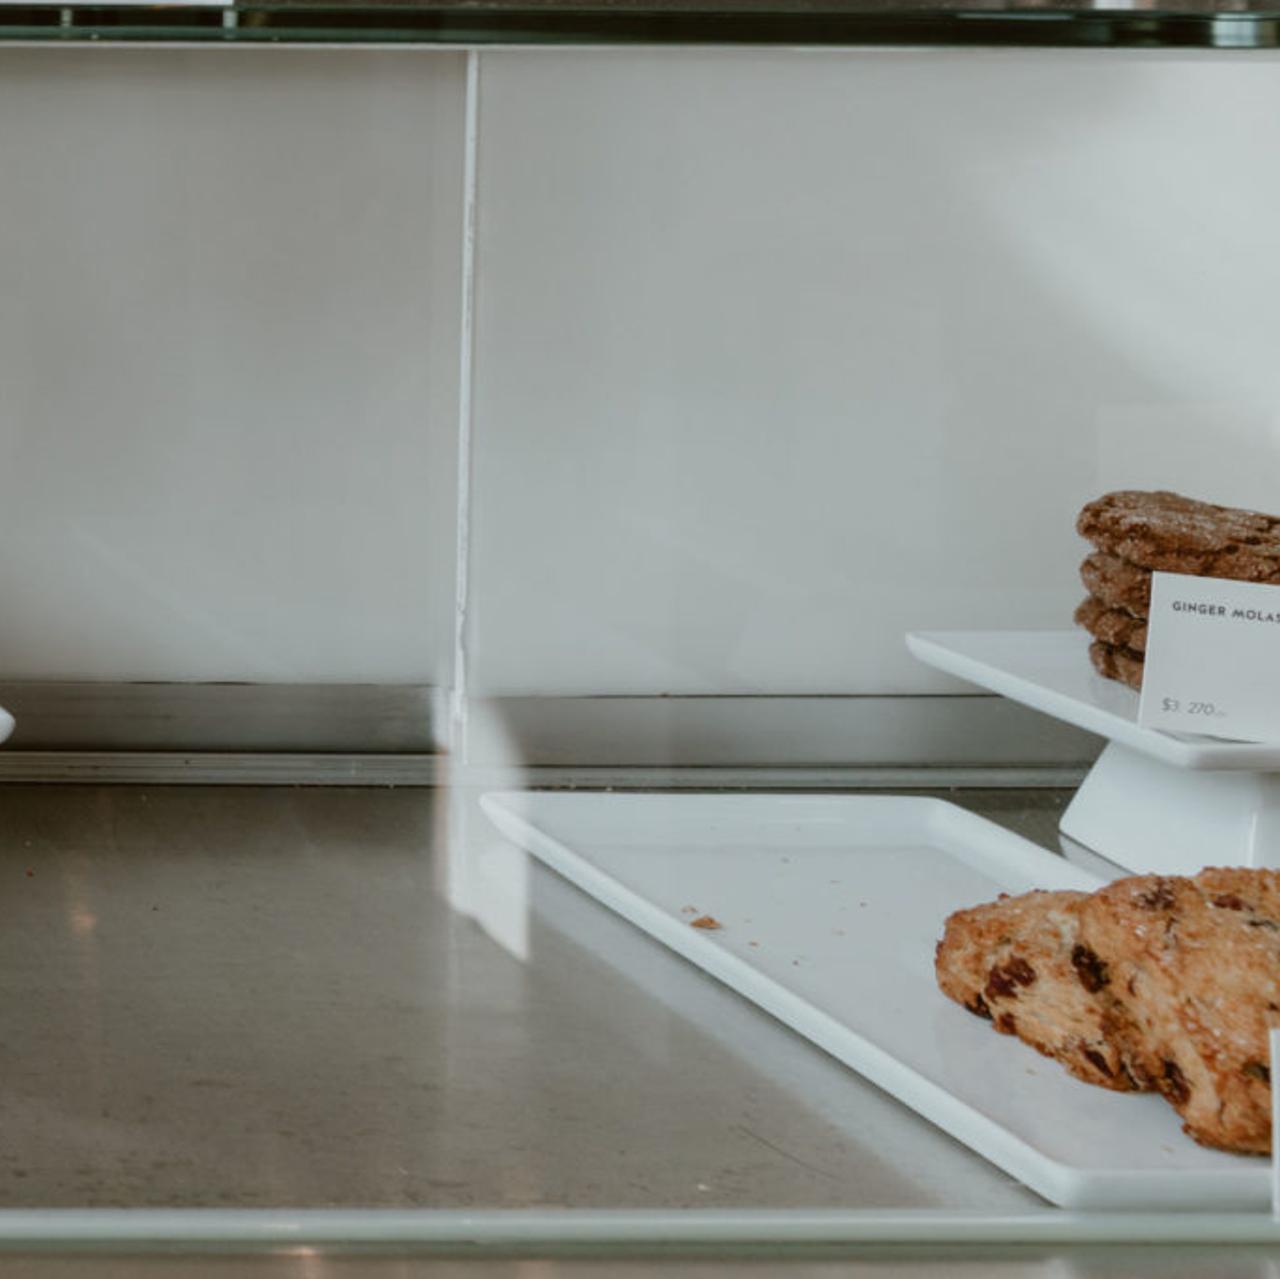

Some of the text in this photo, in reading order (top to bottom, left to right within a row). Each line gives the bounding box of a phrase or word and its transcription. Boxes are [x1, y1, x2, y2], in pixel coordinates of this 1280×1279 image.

[1173, 601, 1226, 615] GINGER
[1162, 698, 1179, 712] $3
[1188, 702, 1214, 716] 270
